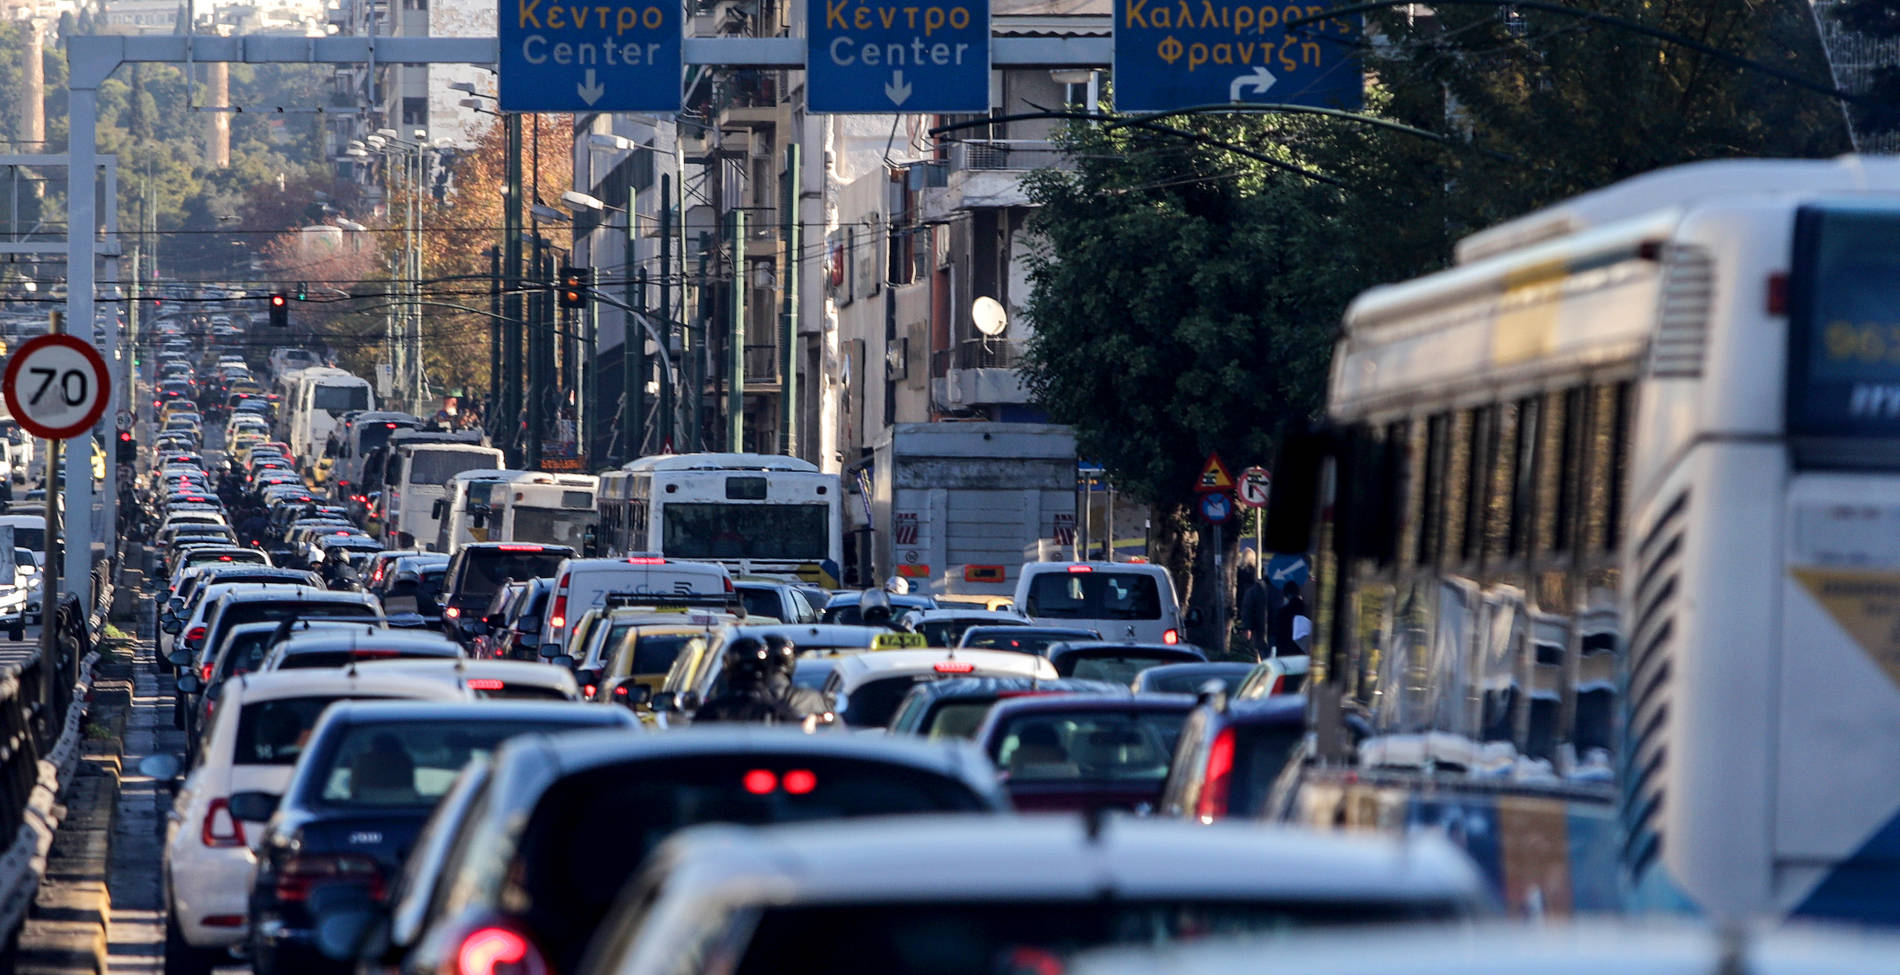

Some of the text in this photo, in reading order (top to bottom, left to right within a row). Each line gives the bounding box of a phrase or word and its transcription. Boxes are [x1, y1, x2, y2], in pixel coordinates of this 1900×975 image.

[523, 34, 661, 65] Center
[830, 35, 969, 66] Center
[30, 367, 88, 407] 70
